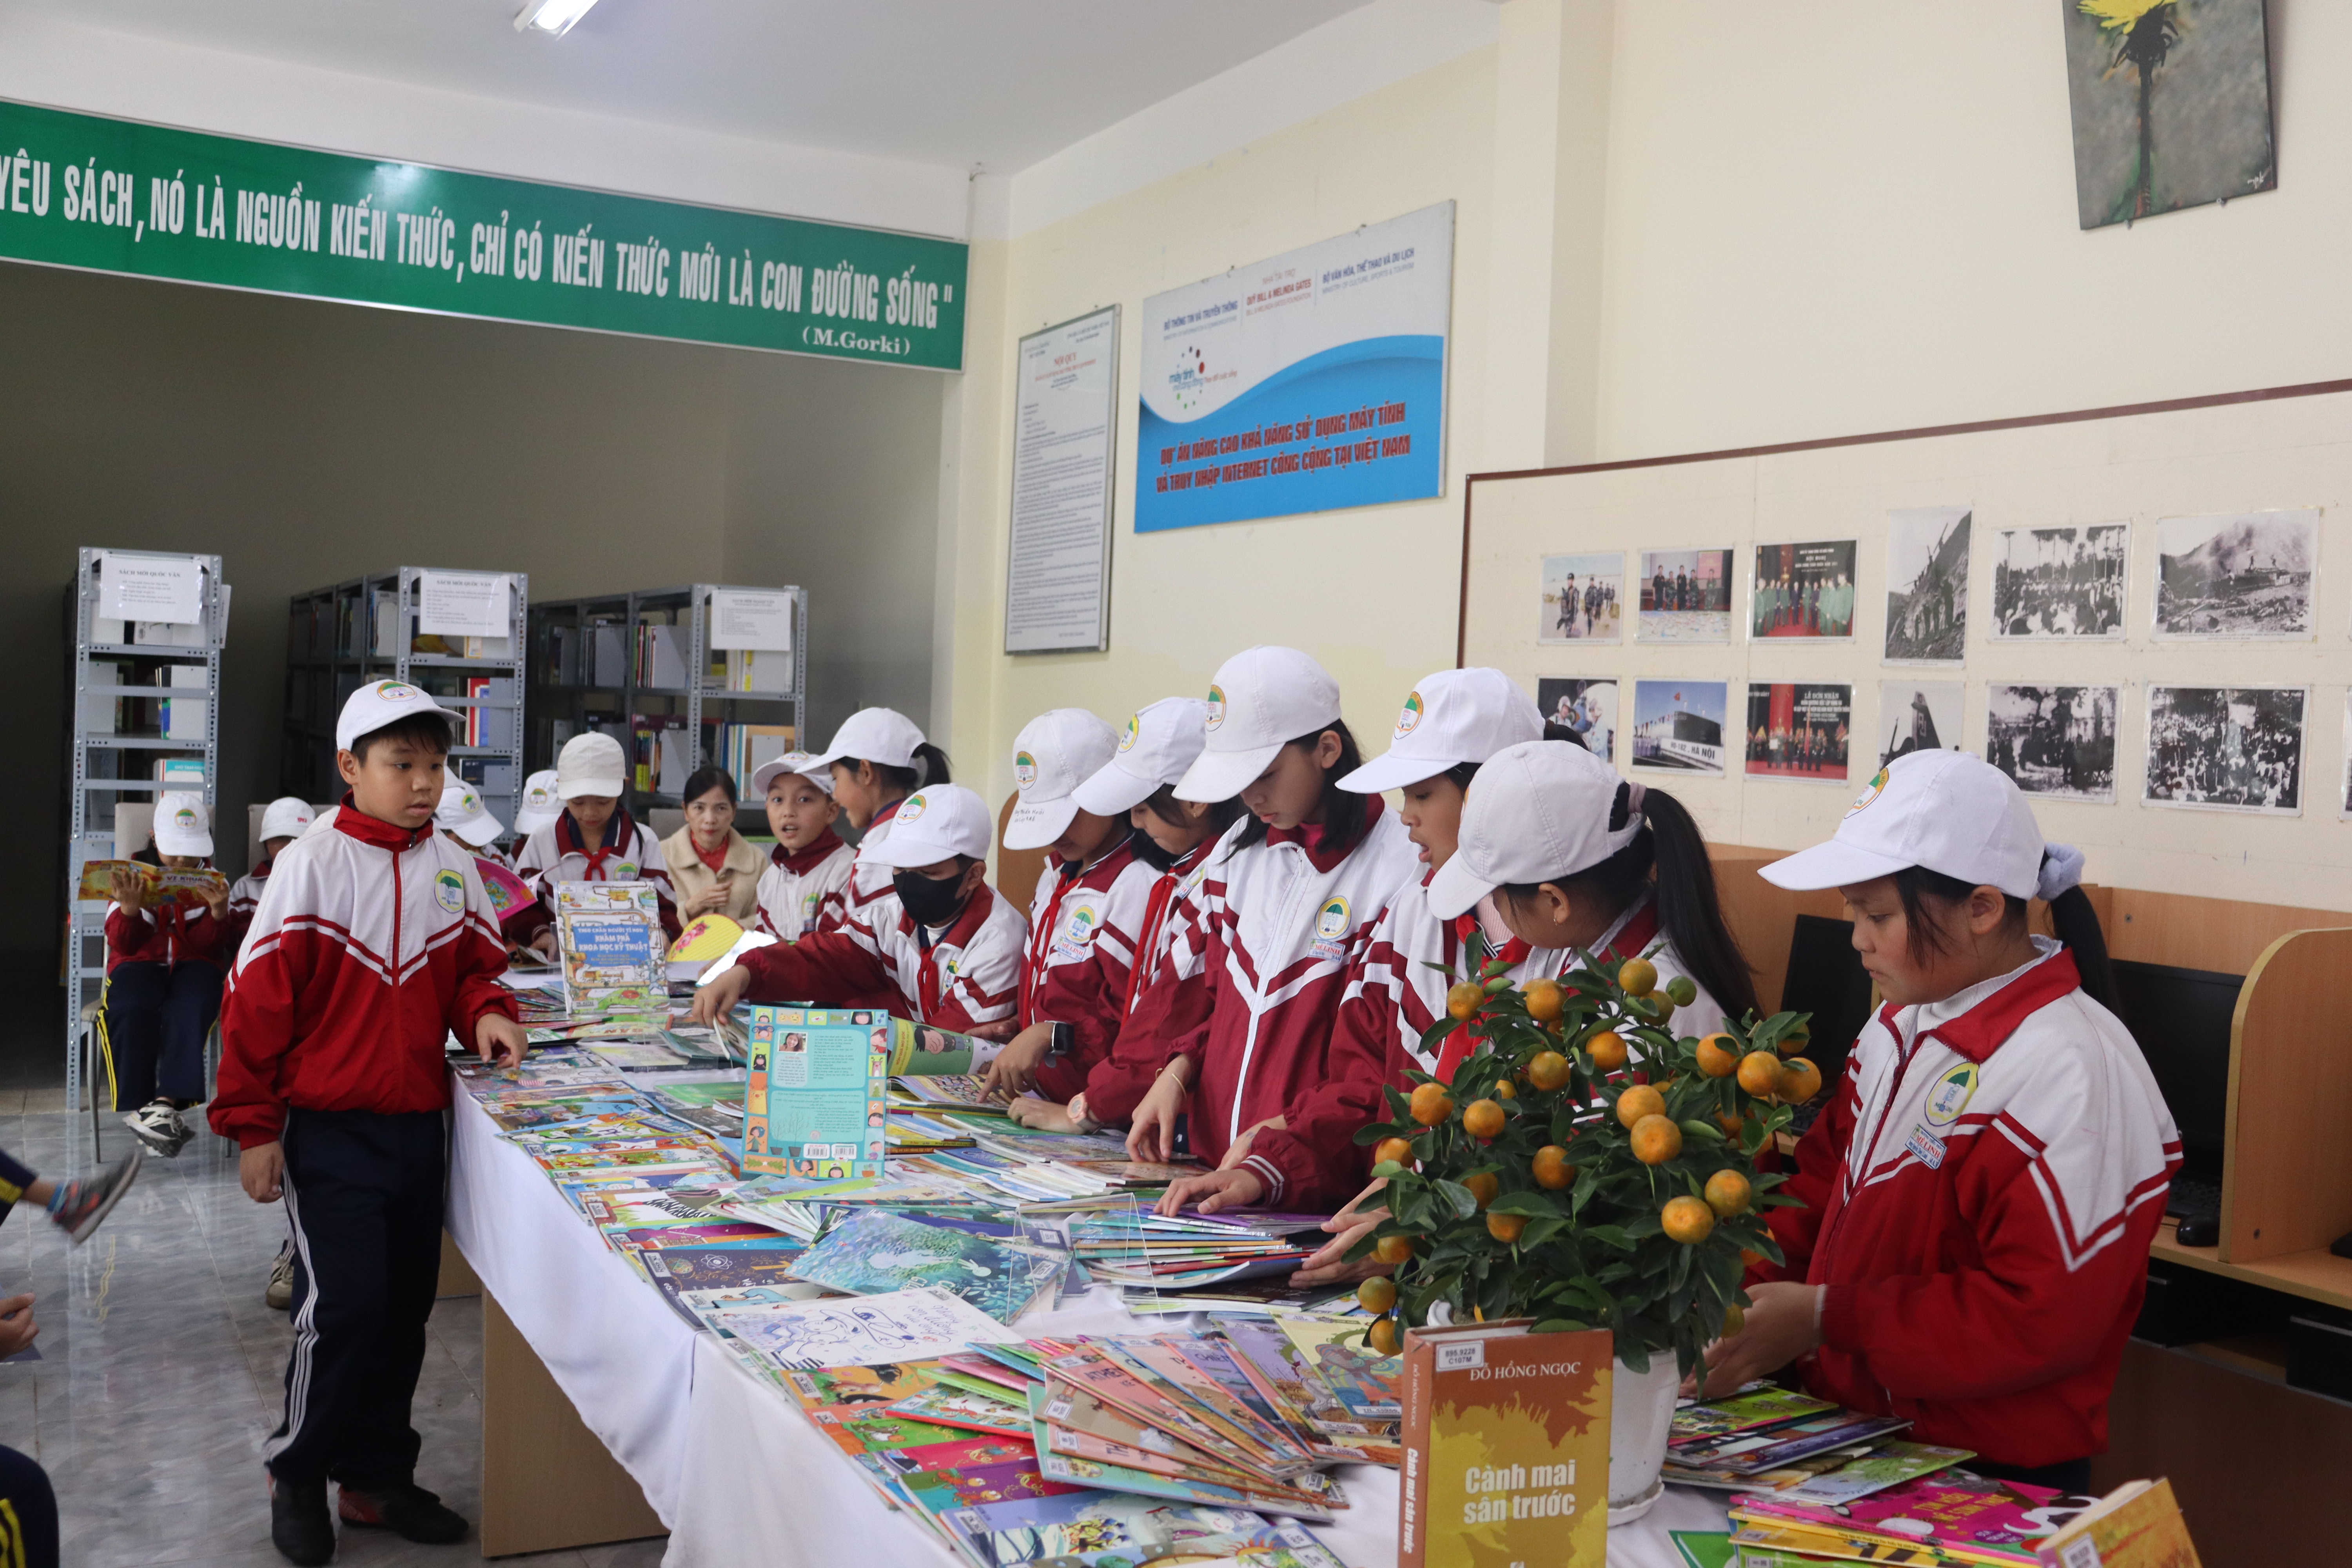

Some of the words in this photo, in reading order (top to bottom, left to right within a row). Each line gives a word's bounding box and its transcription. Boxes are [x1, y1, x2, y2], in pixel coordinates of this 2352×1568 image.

[64, 157, 144, 243] SÁCH,
[150, 169, 185, 235] NÓ
[196, 175, 226, 240] LÀ
[236, 181, 321, 252] NGUỒN
[329, 193, 387, 261] KIẾN
[397, 206, 464, 283] THỨC,
[471, 210, 508, 276] CHỈ
[513, 220, 543, 281] CÓ
[552, 224, 605, 289] KIẾN
[615, 236, 670, 298] THỨC
[679, 242, 721, 303] MỚI
[728, 249, 754, 307] LÀ
[760, 261, 803, 313] CON
[811, 260, 879, 322] ĐƯỜNG
[1392, 252, 1400, 263] DU
[1257, 292, 1267, 303] BILL
[1273, 284, 1294, 297] MELINDA
[1296, 278, 1312, 291] GATES
[1160, 446, 1176, 468] DỰ
[1177, 441, 1191, 463] ÁN
[1192, 437, 1218, 460] NÂNG
[1219, 434, 1240, 455] CAO
[1241, 424, 1262, 450] KHẢ
[1264, 422, 1293, 446] NĂNG
[1295, 414, 1313, 441] SỬ
[1315, 414, 1346, 441] DỤNG
[1348, 405, 1376, 432] MÁY
[1377, 399, 1406, 426] TÍNH
[1156, 472, 1168, 493] VÀ
[1169, 472, 1193, 491] TRUY
[1194, 463, 1220, 489] NHẬP
[1222, 458, 1269, 483] INTERNET
[1270, 451, 1299, 475] CÔNG
[1301, 445, 1332, 475] CỘNG
[1334, 444, 1352, 469] TẠI
[1354, 436, 1380, 465] VIỆT
[1381, 434, 1411, 458] NAM
[1691, 746, 1700, 755] HÀ
[1702, 748, 1715, 760] NỘI
[595, 933, 616, 942] KHÁM
[617, 933, 631, 942] PHÁ
[599, 944, 614, 953] HỌC
[625, 941, 648, 953] THUẬT
[1070, 946, 1083, 955] LINH
[1323, 945, 1341, 955] LINH
[1916, 1134, 1926, 1145] MÊ
[1924, 1142, 1940, 1159] LINH
[1445, 1347, 1476, 1357] 895.9228
[1448, 1356, 1473, 1365] C107M
[1470, 1364, 1491, 1381] ĐỖ
[1495, 1360, 1536, 1379] HỒNG
[1540, 1362, 1581, 1377] NGỌC
[1465, 1463, 1526, 1494] Cành
[1530, 1459, 1576, 1488] mai
[1406, 1479, 1416, 1503] mai
[1405, 1503, 1415, 1523] sân
[1463, 1495, 1507, 1524] sân
[1512, 1489, 1576, 1520] trước
[1403, 1523, 1415, 1554] trước
